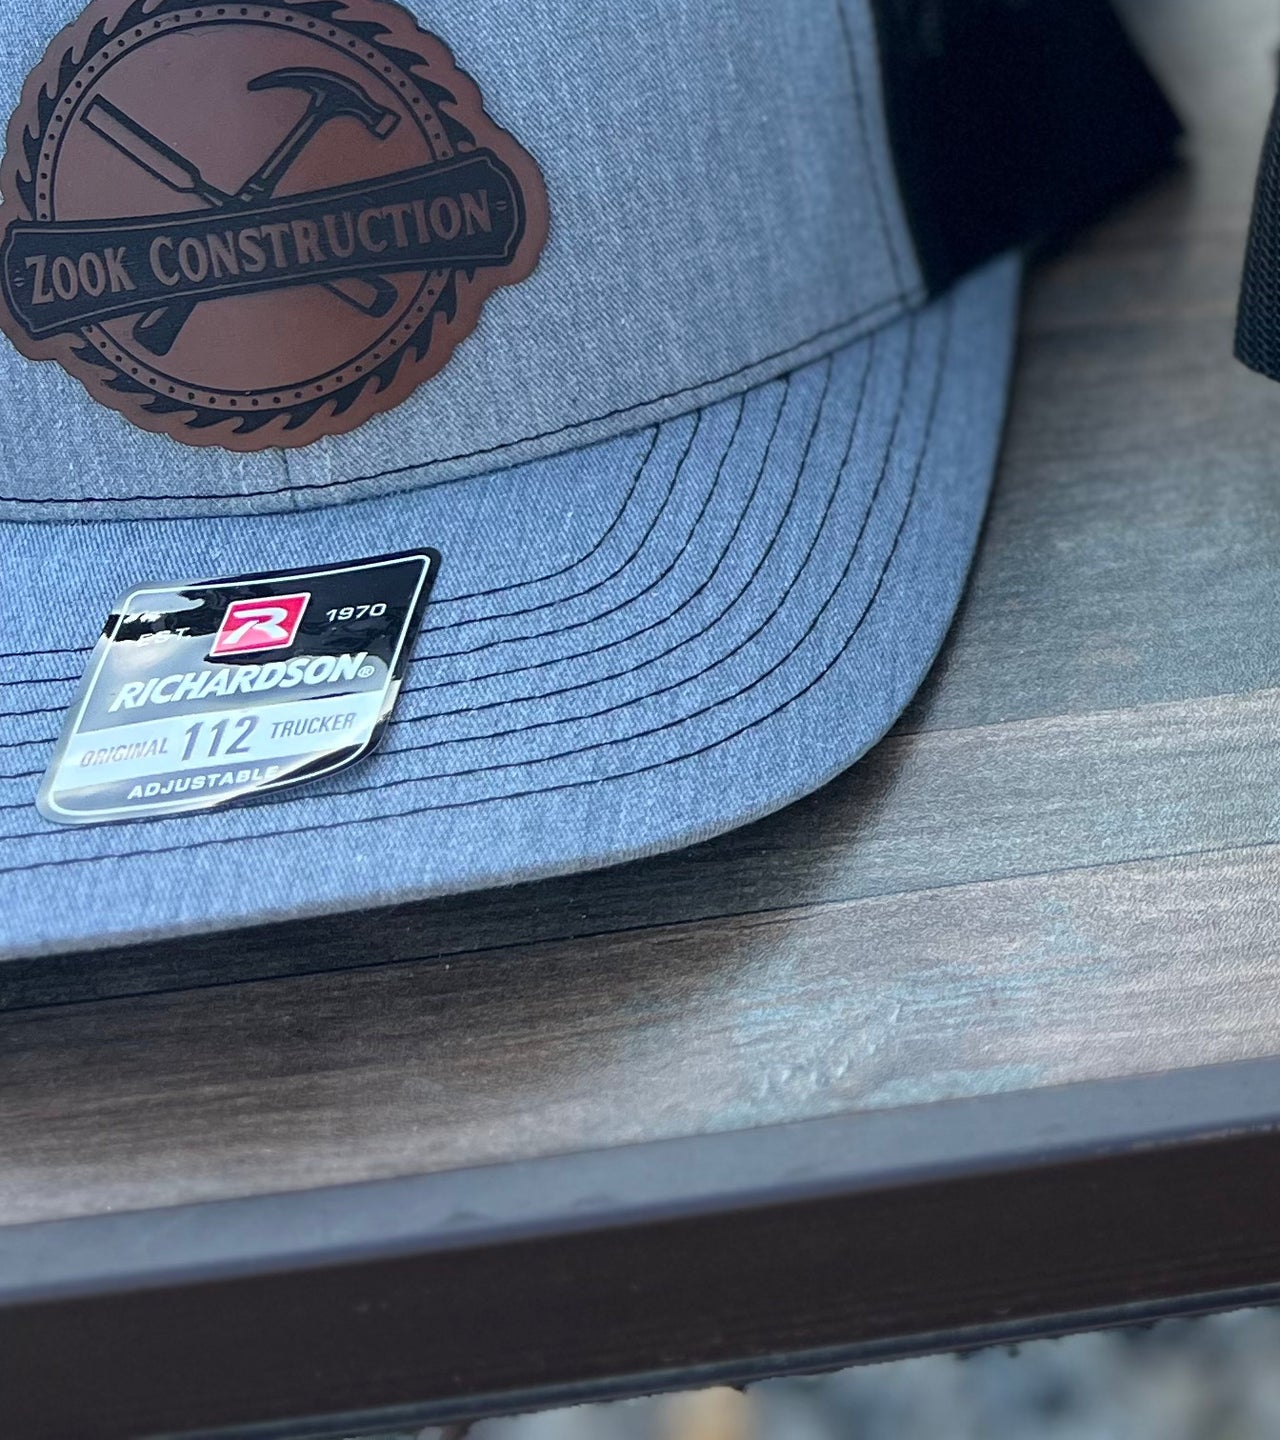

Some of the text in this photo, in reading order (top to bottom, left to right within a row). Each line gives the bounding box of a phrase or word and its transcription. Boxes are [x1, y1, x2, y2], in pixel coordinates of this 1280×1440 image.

[25, 188, 494, 305] ZOOK CONSTRUCTION
[325, 602, 387, 622] 1970
[80, 712, 357, 768] ORIGINAL 112 TRUCKER
[127, 764, 281, 800] ADJUSTABLE
